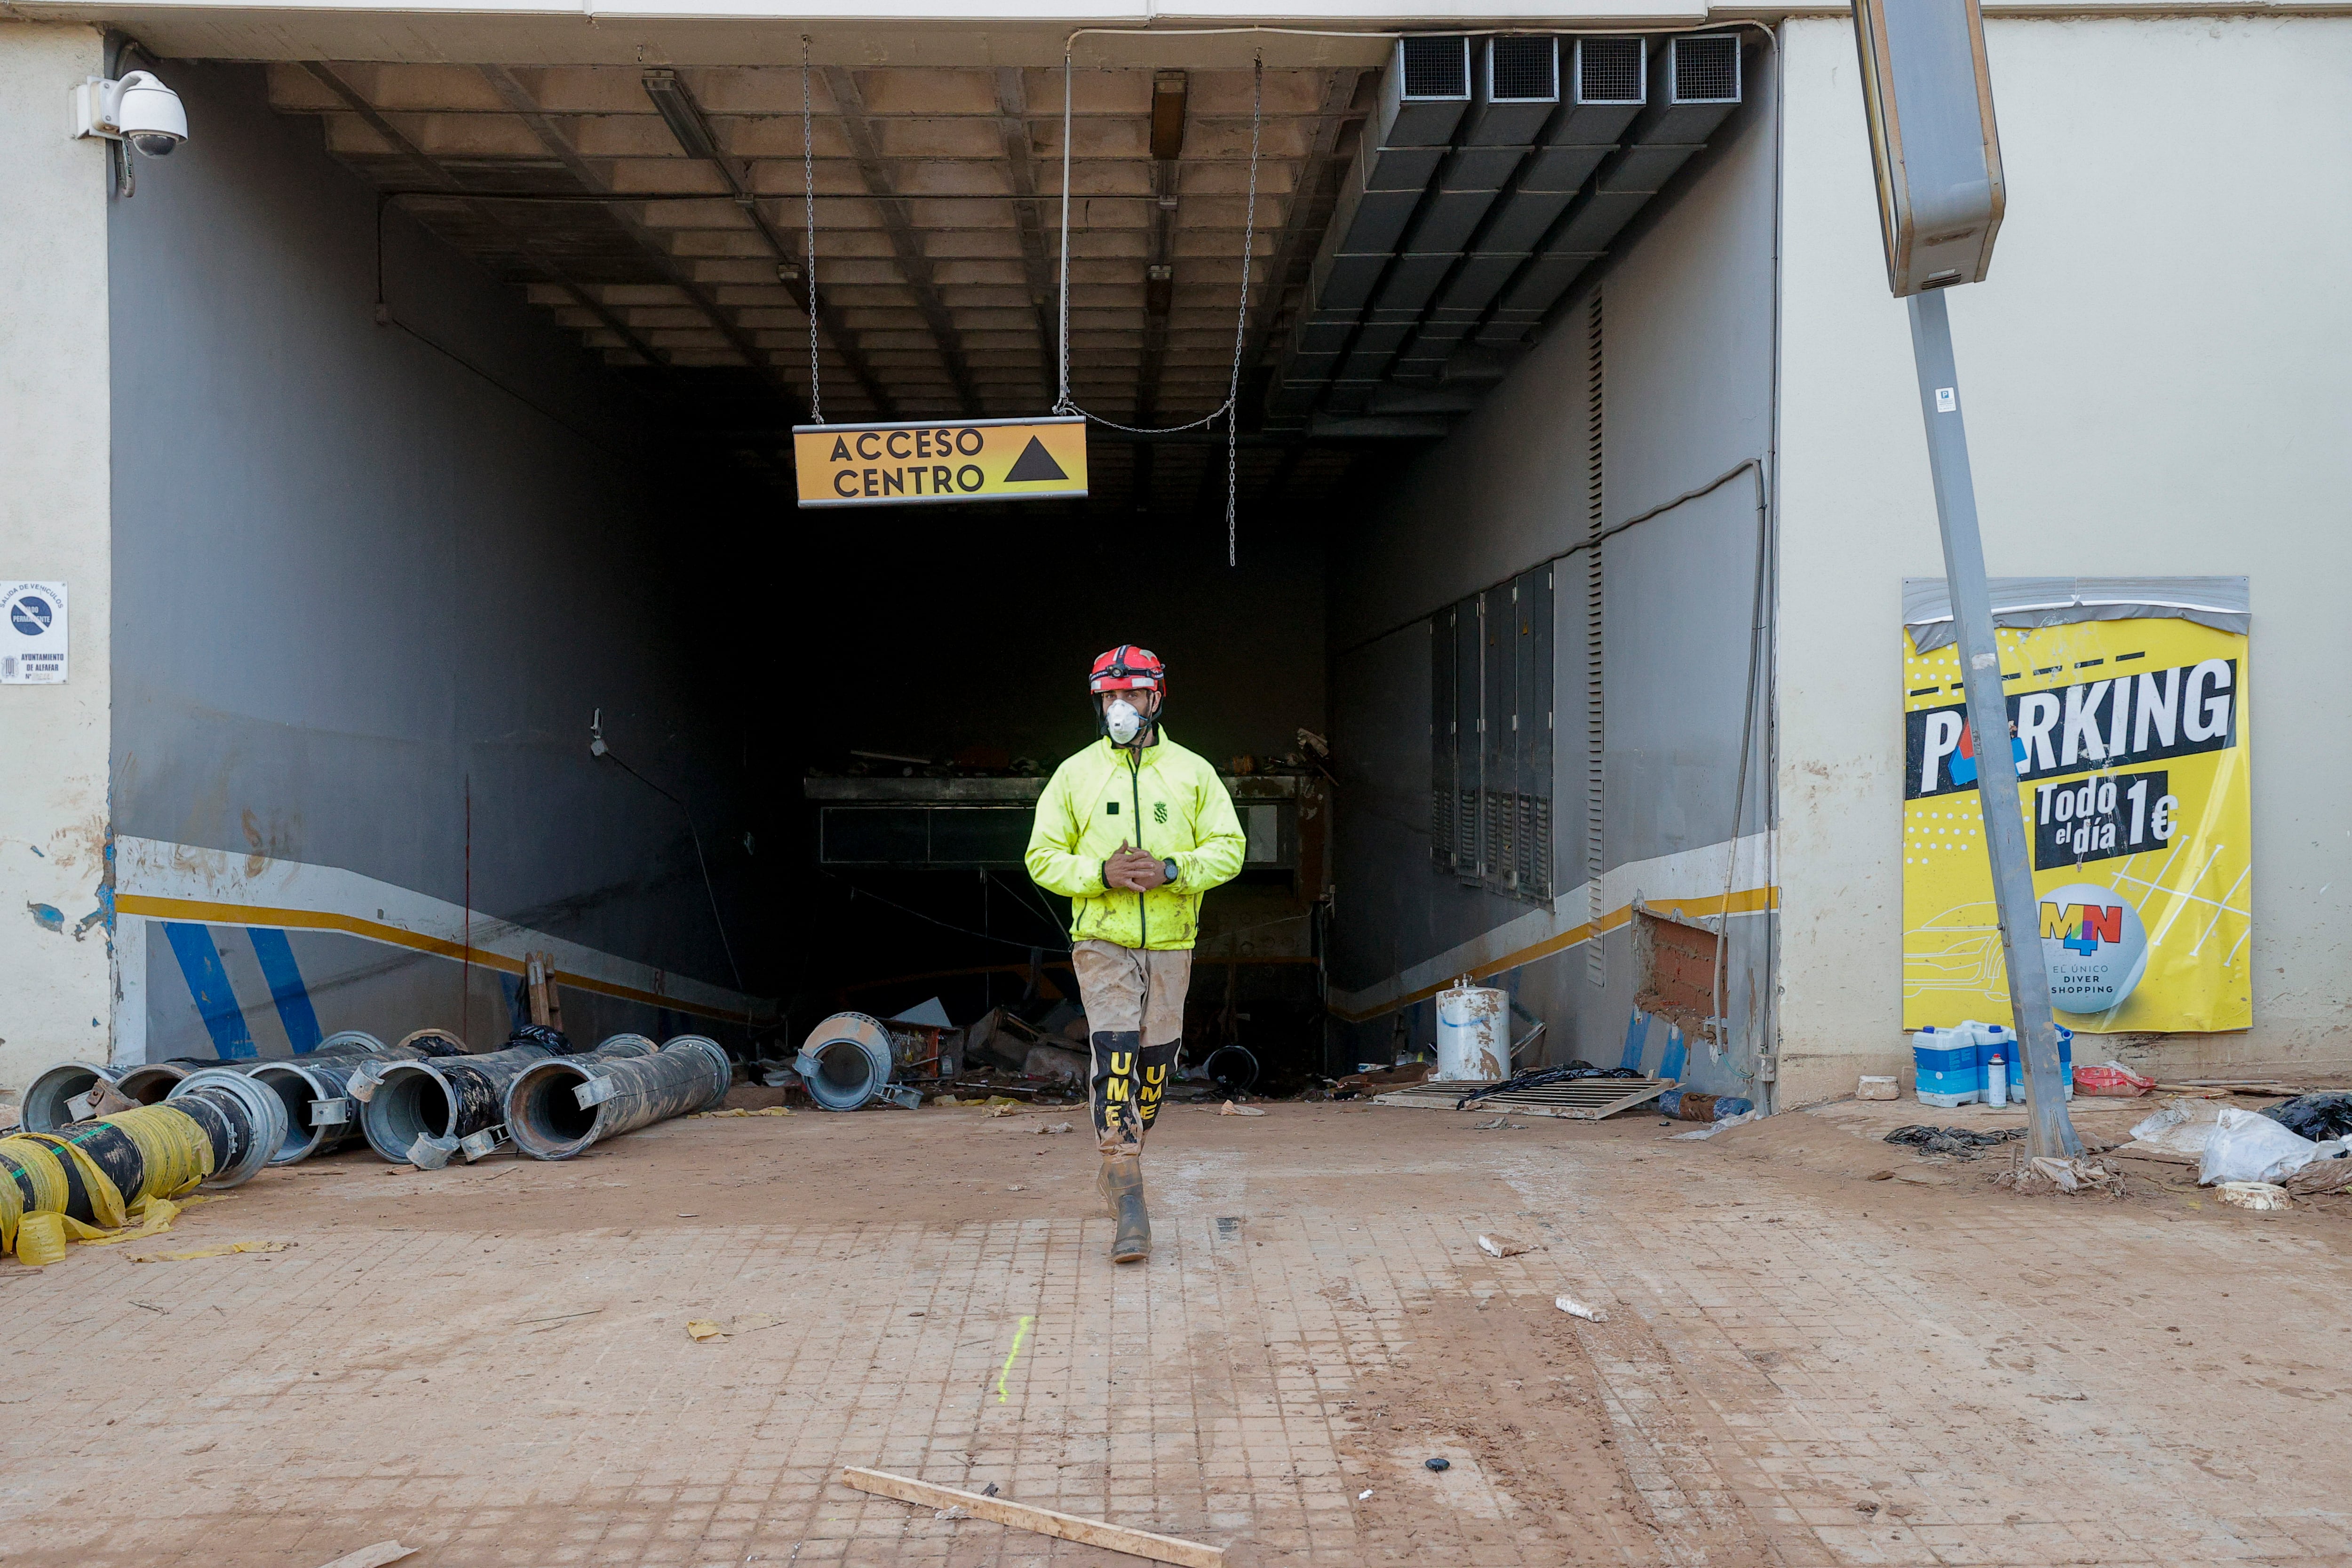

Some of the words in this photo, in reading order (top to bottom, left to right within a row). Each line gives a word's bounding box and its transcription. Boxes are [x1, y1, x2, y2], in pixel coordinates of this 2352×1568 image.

[830, 429, 983, 462] ACCESO
[834, 464, 984, 497] CENTRO
[0, 588, 18, 608] SALIDA
[31, 583, 64, 608] VEHICULOS
[2038, 775, 2117, 825] Todo
[2055, 822, 2072, 845] el
[2073, 817, 2116, 854] día
[2072, 964, 2108, 973] ÚNICO
[1105, 1051, 1132, 1127] UME
[1140, 1063, 1166, 1120] UME
